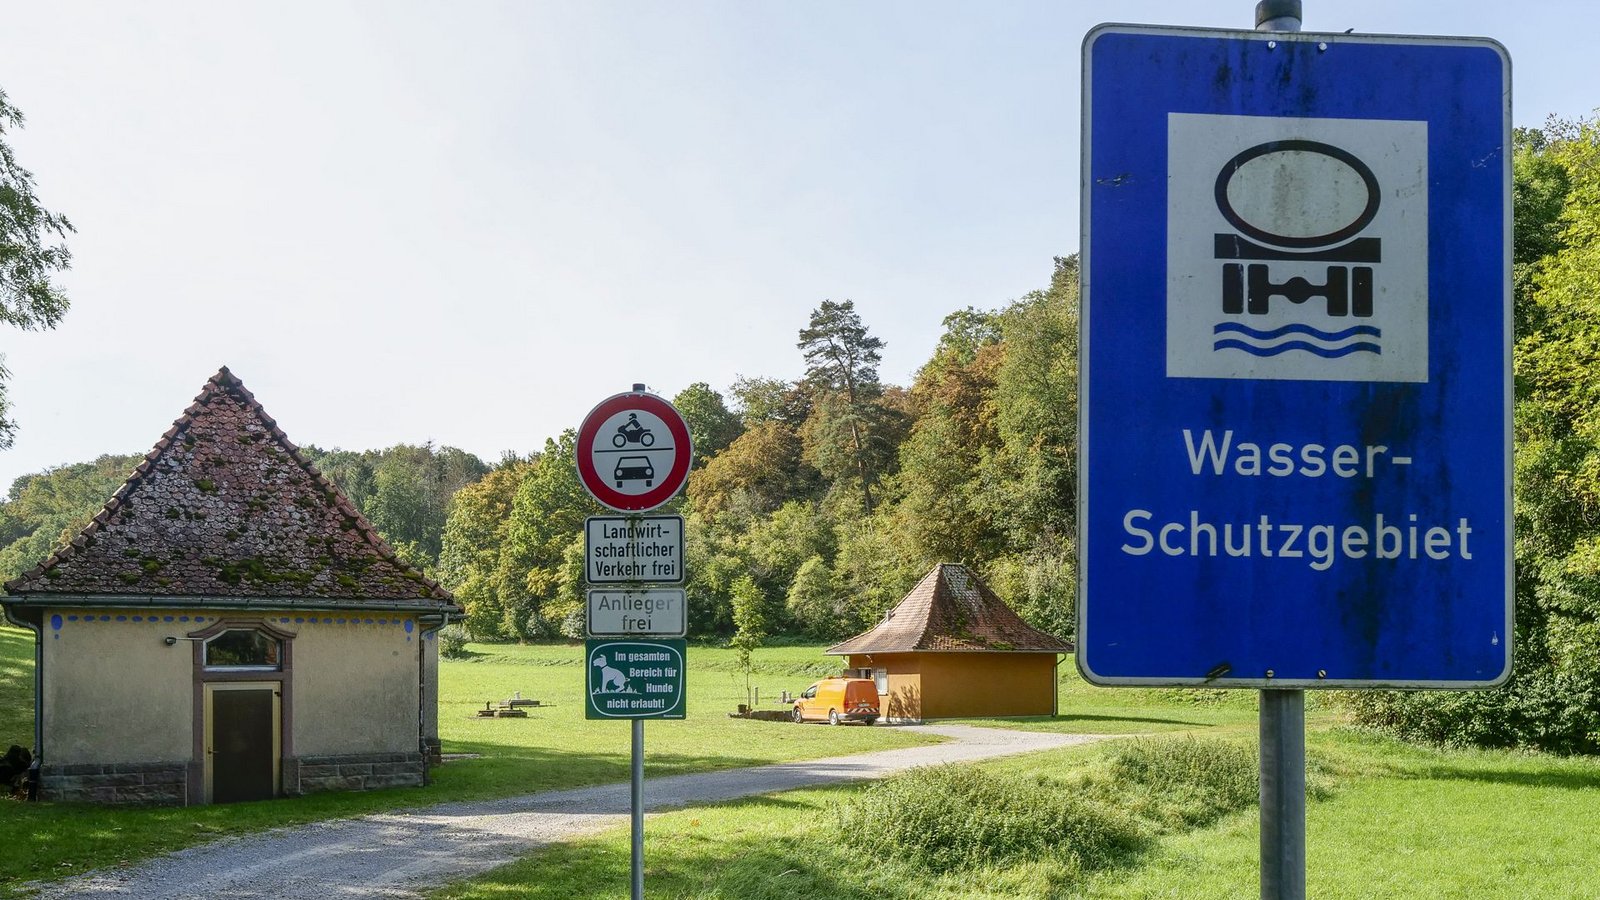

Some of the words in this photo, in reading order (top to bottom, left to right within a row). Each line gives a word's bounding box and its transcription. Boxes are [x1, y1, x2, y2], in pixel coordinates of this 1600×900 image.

[1183, 429, 1412, 478] Wasser-
[603, 523, 670, 539] Landwirt-
[1121, 509, 1473, 571] Schutzgebiet
[595, 542, 675, 558] schaftlicher
[595, 561, 646, 576] Verkehr
[652, 560, 675, 576] frei
[599, 595, 674, 614] Anlieger
[622, 615, 652, 630] frei
[615, 652, 626, 661] Im
[628, 652, 670, 664] gesamten
[629, 668, 663, 677] Bereich
[664, 668, 677, 677] für
[646, 683, 673, 693] Hunde
[607, 699, 629, 709] nicht
[631, 699, 665, 709] erlaubt!
